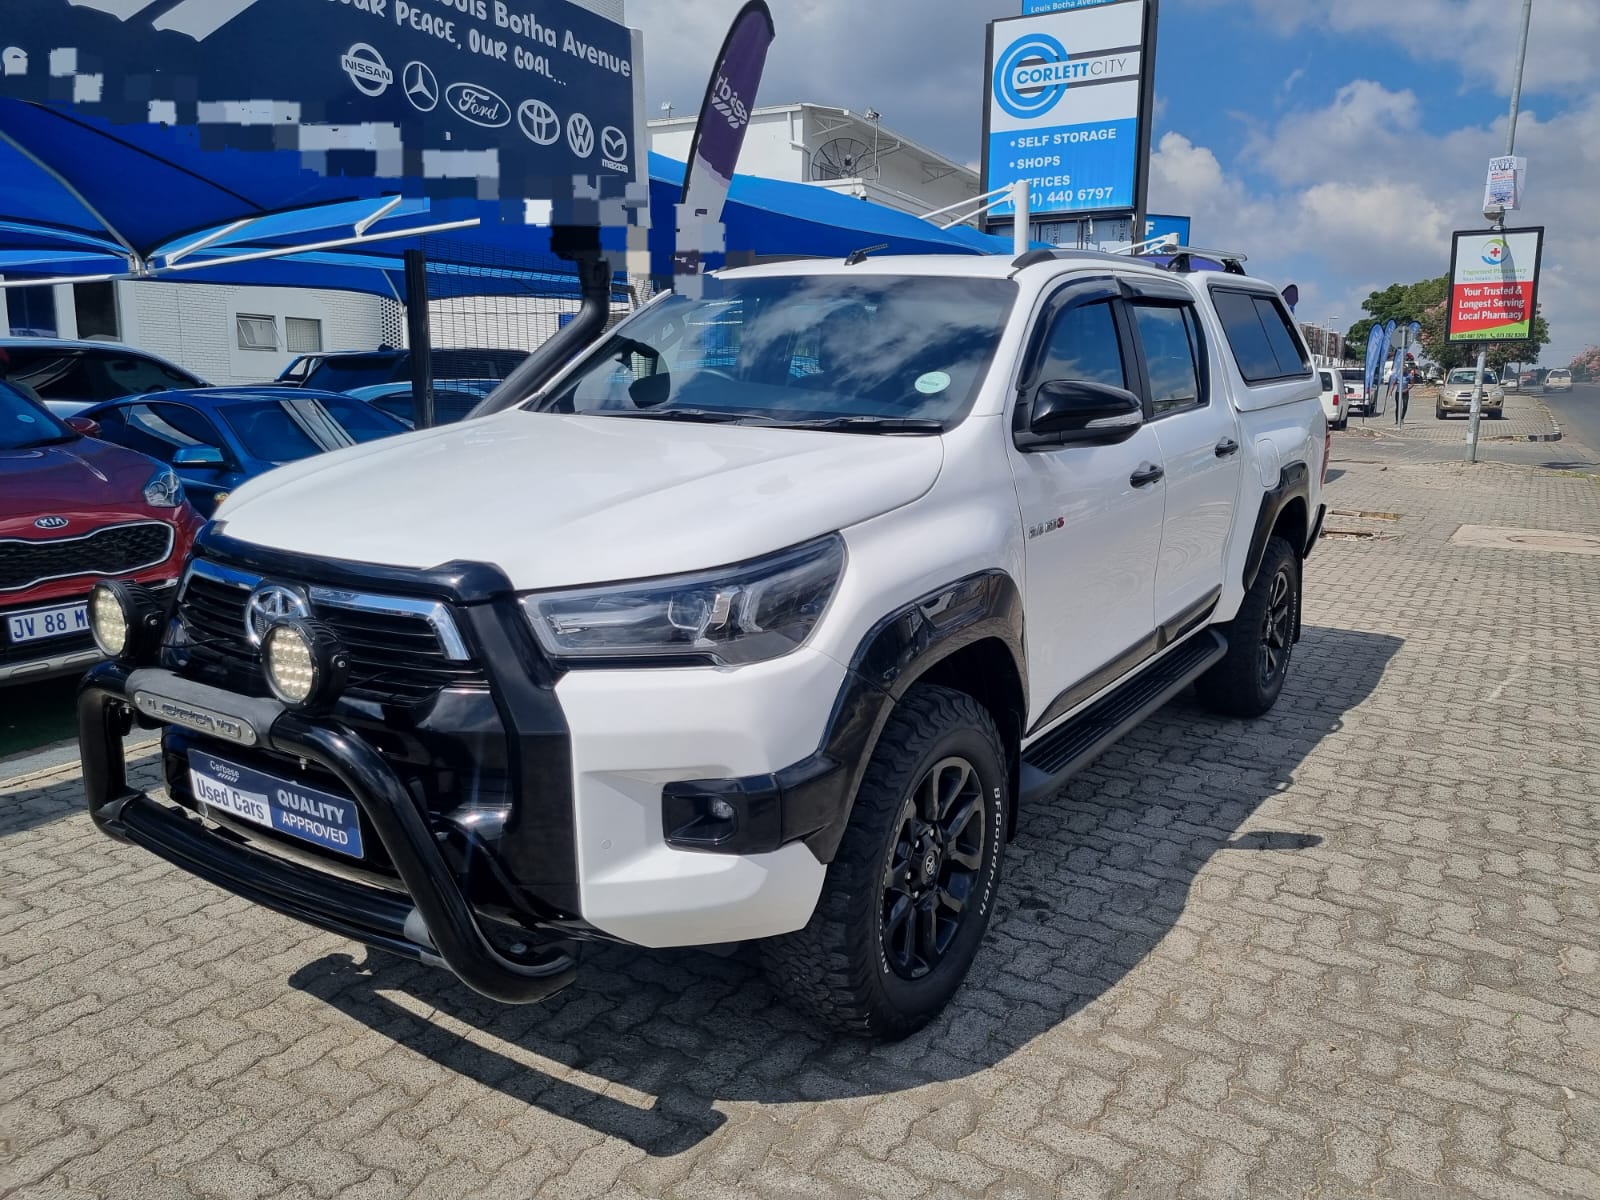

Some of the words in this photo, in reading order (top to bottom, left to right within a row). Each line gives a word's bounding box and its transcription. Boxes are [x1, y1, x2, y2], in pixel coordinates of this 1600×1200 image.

[1052, 1, 1075, 10] Botha
[468, 29, 508, 62] OUR
[495, 0, 557, 48] Botha
[563, 30, 631, 77] Avenue
[345, 59, 390, 81] NISSAN
[458, 89, 500, 121] Ford
[1018, 135, 1049, 148] SELF
[1053, 128, 1117, 145] STORAGE
[602, 158, 629, 173] mazda
[1017, 155, 1060, 169] SHOPS
[1047, 190, 1073, 203] 440
[1078, 187, 1114, 201] 6797
[1463, 287, 1482, 297] Your
[1484, 286, 1514, 296] Trusted
[1515, 285, 1522, 295] &
[1459, 299, 1491, 310] Longest
[1493, 298, 1525, 309] Serving
[1458, 311, 1480, 320] Local
[1482, 310, 1523, 321] Pharmacy
[39, 517, 65, 527] KIA
[14, 617, 35, 639] JV
[44, 612, 67, 634] 88
[209, 760, 240, 778] Carbase
[197, 777, 230, 807] Used
[232, 790, 265, 820] Cars
[277, 789, 344, 825] QUALITY
[282, 811, 349, 845] APPROVED
